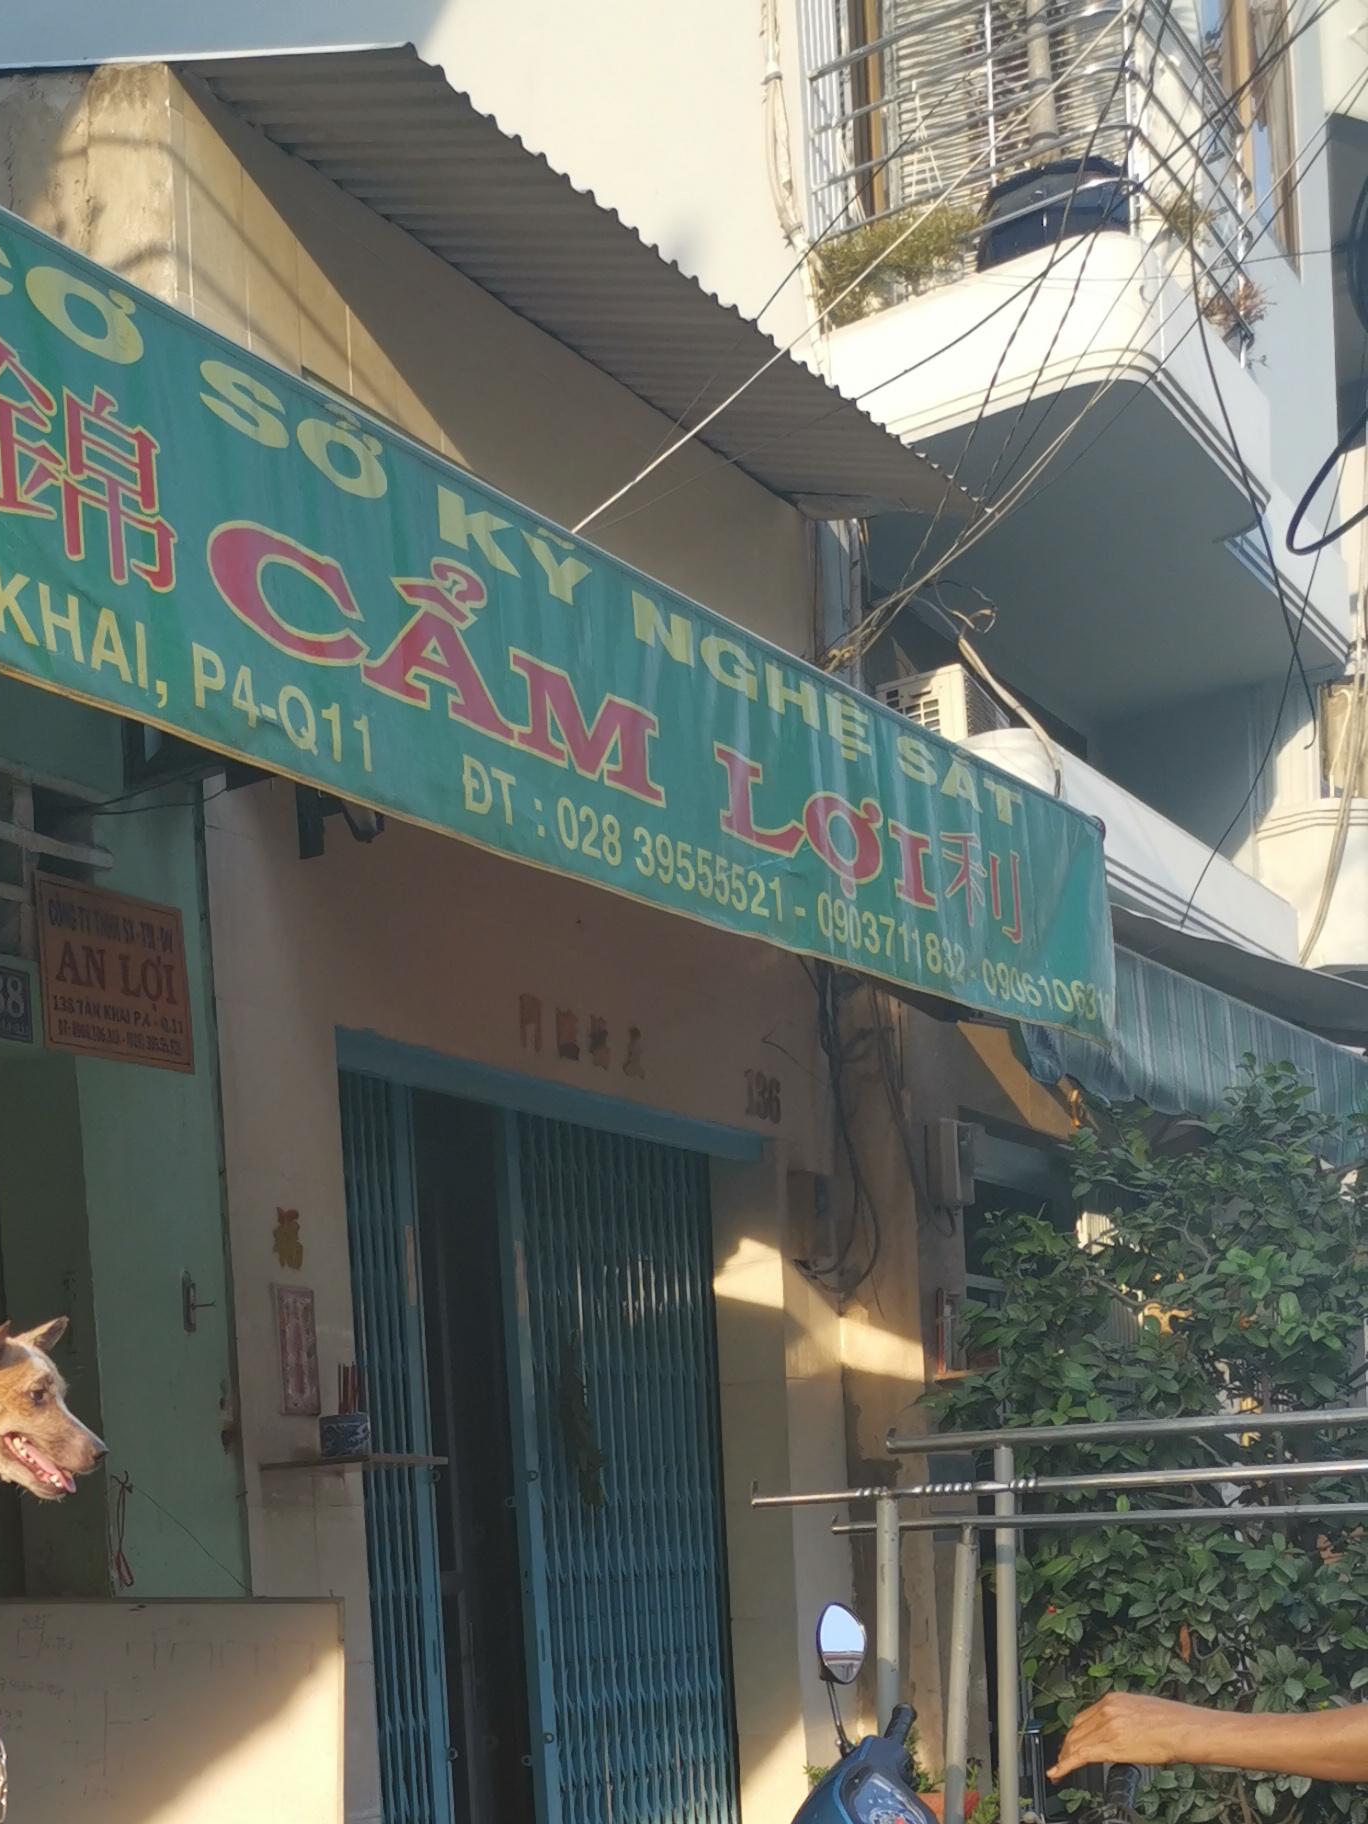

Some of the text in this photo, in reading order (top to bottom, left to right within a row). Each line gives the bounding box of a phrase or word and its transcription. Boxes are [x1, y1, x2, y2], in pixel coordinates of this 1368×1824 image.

[199, 360, 388, 500] SỞ
[437, 486, 593, 606] KỸ
[631, 590, 871, 763] NGHỆ
[192, 641, 376, 775] P4-Q11
[206, 519, 939, 913] CẨM LỢI
[462, 754, 518, 826] ĐT
[557, 798, 624, 869] 028
[635, 822, 785, 924] 39555521
[817, 892, 967, 985] 0903711832
[941, 829, 1027, 945] 利
[56, 941, 178, 1012] AN LỢI
[744, 1068, 781, 1124] 136
